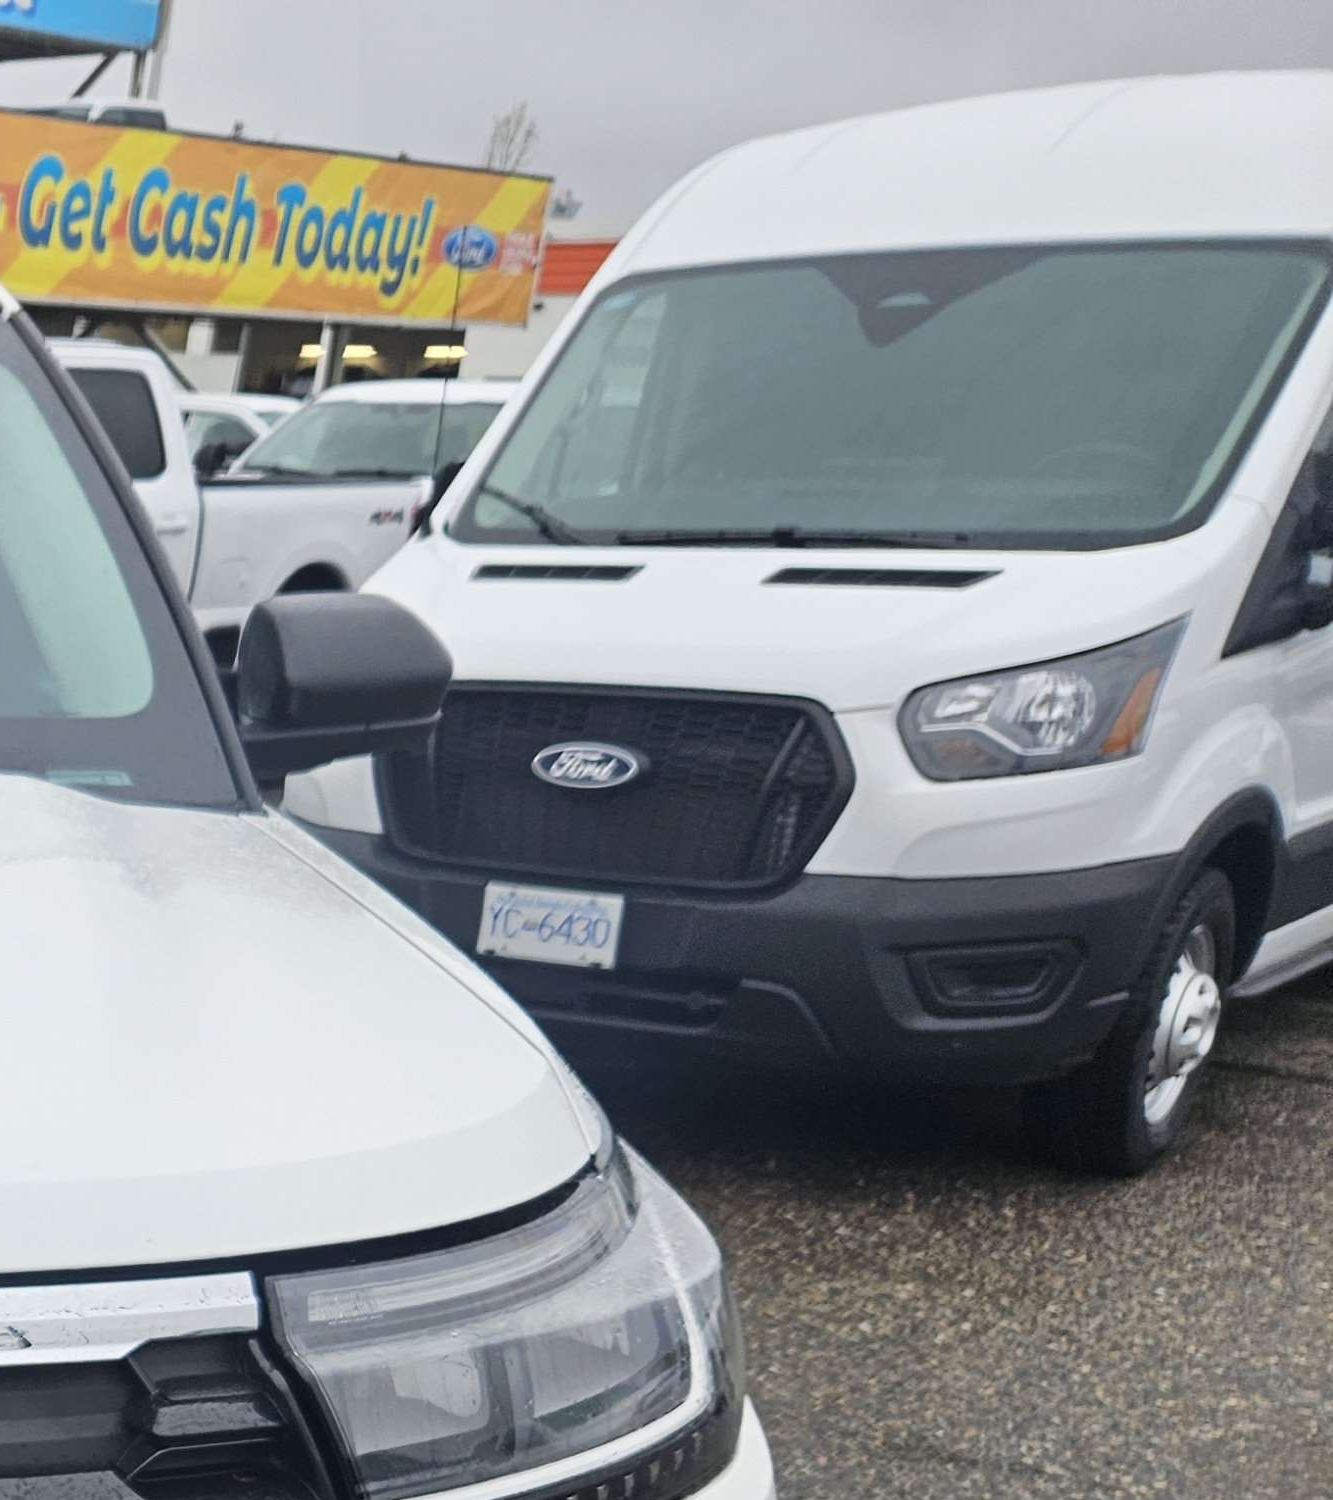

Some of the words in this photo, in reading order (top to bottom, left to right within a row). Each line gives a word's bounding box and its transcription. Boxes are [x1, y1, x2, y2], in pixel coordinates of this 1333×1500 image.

[19, 154, 117, 253] Get
[130, 167, 258, 266] Cash
[271, 181, 435, 297] Today!
[548, 750, 618, 781] Ford
